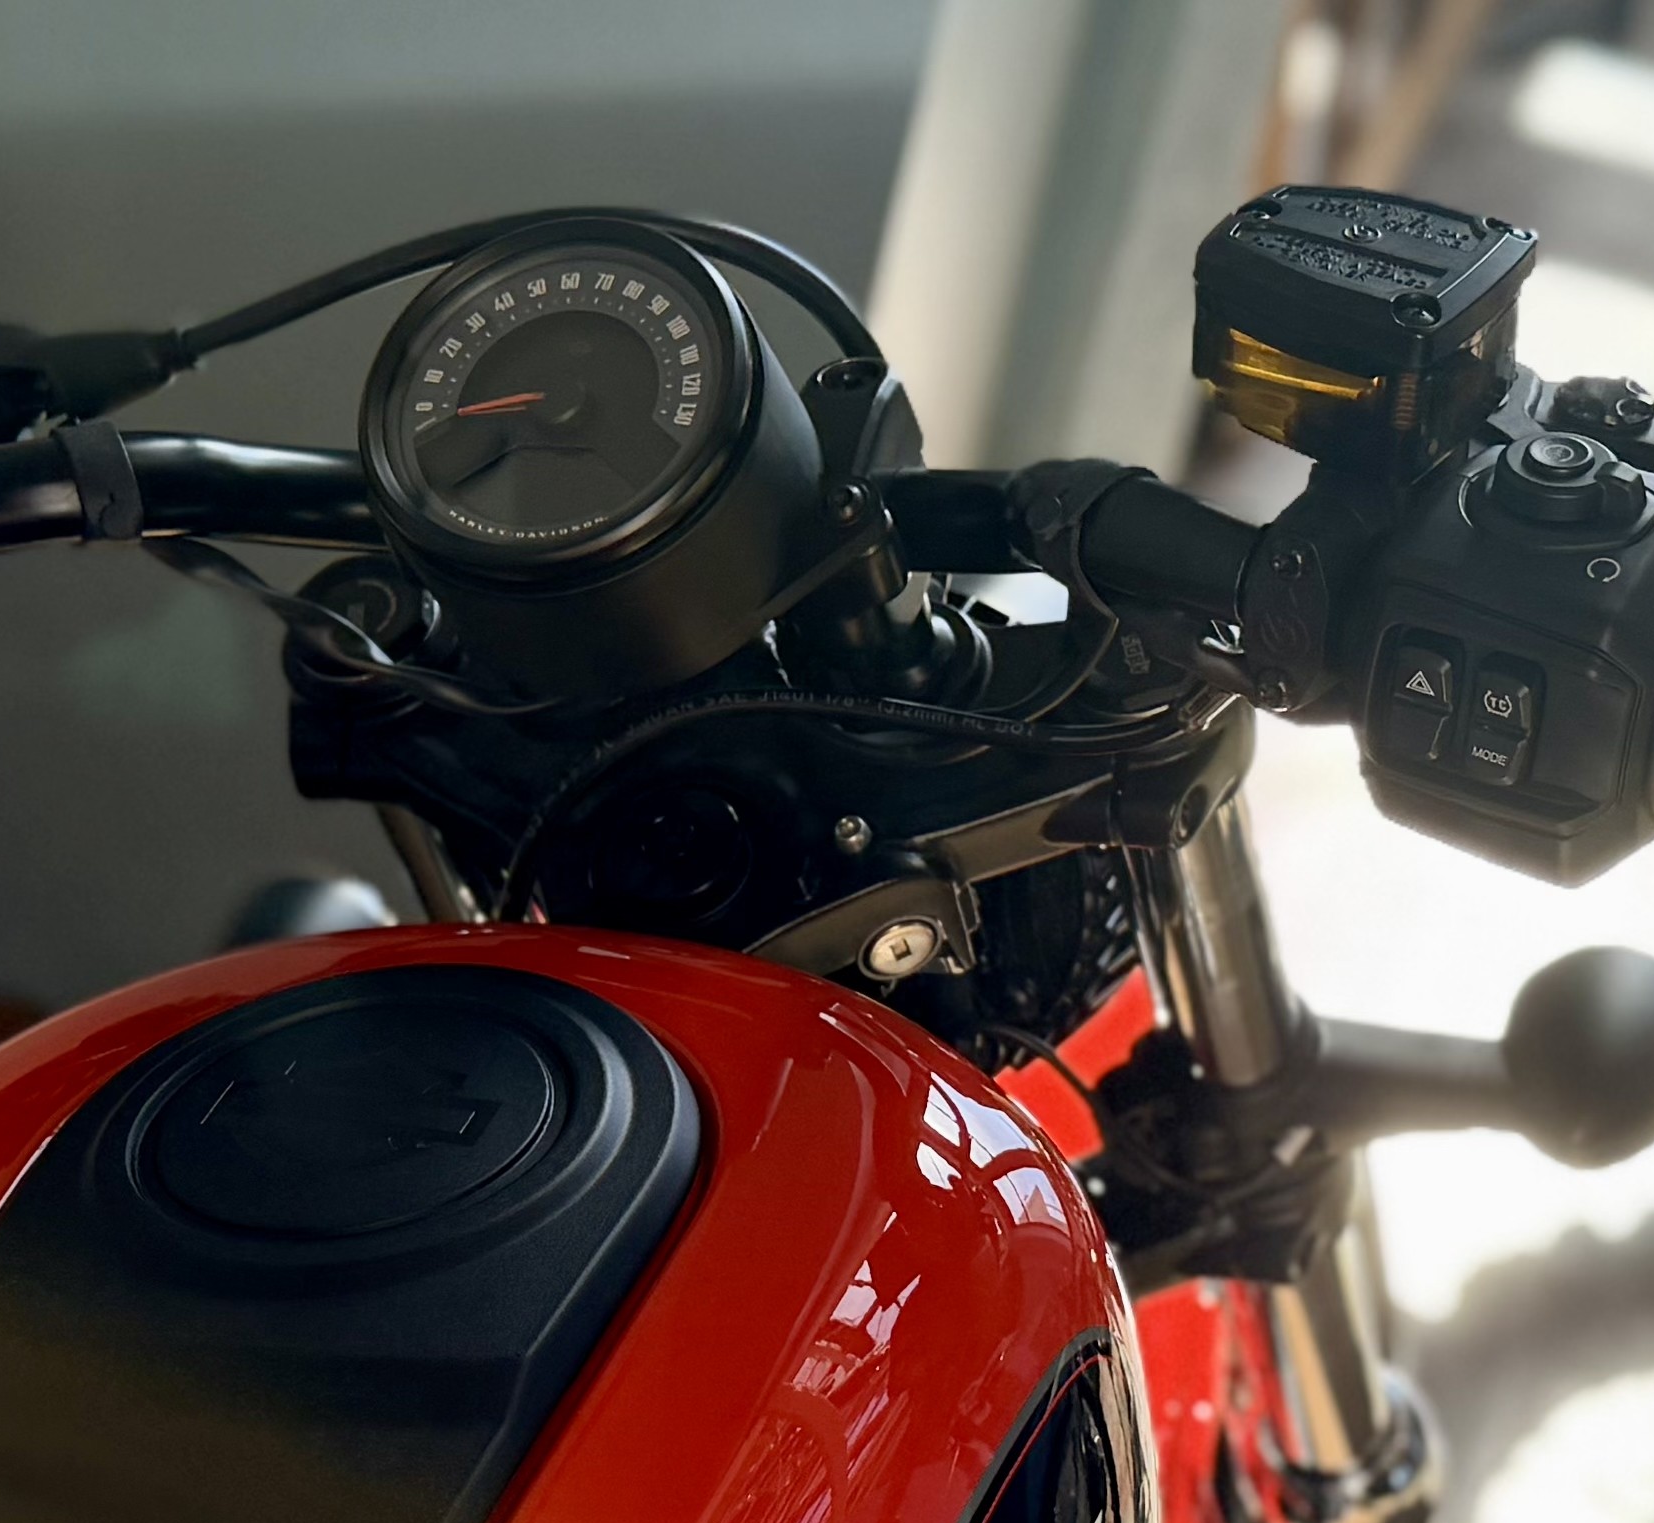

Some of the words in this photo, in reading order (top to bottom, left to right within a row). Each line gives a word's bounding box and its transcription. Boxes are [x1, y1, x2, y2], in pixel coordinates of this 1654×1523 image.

[527, 278, 546, 297] 50
[561, 272, 580, 290] 60
[595, 272, 615, 291] 70
[622, 280, 645, 300] 80
[495, 292, 515, 311] 40
[646, 294, 670, 315] 90
[465, 312, 486, 334] 30
[666, 315, 690, 340] 100
[439, 338, 463, 358] 20
[680, 344, 700, 365] 110
[423, 369, 444, 383] 10
[682, 373, 701, 395] 120
[415, 402, 433, 411] 0
[673, 403, 697, 425] 130
[1489, 696, 1507, 711] TC
[1471, 746, 1508, 767] MODE
